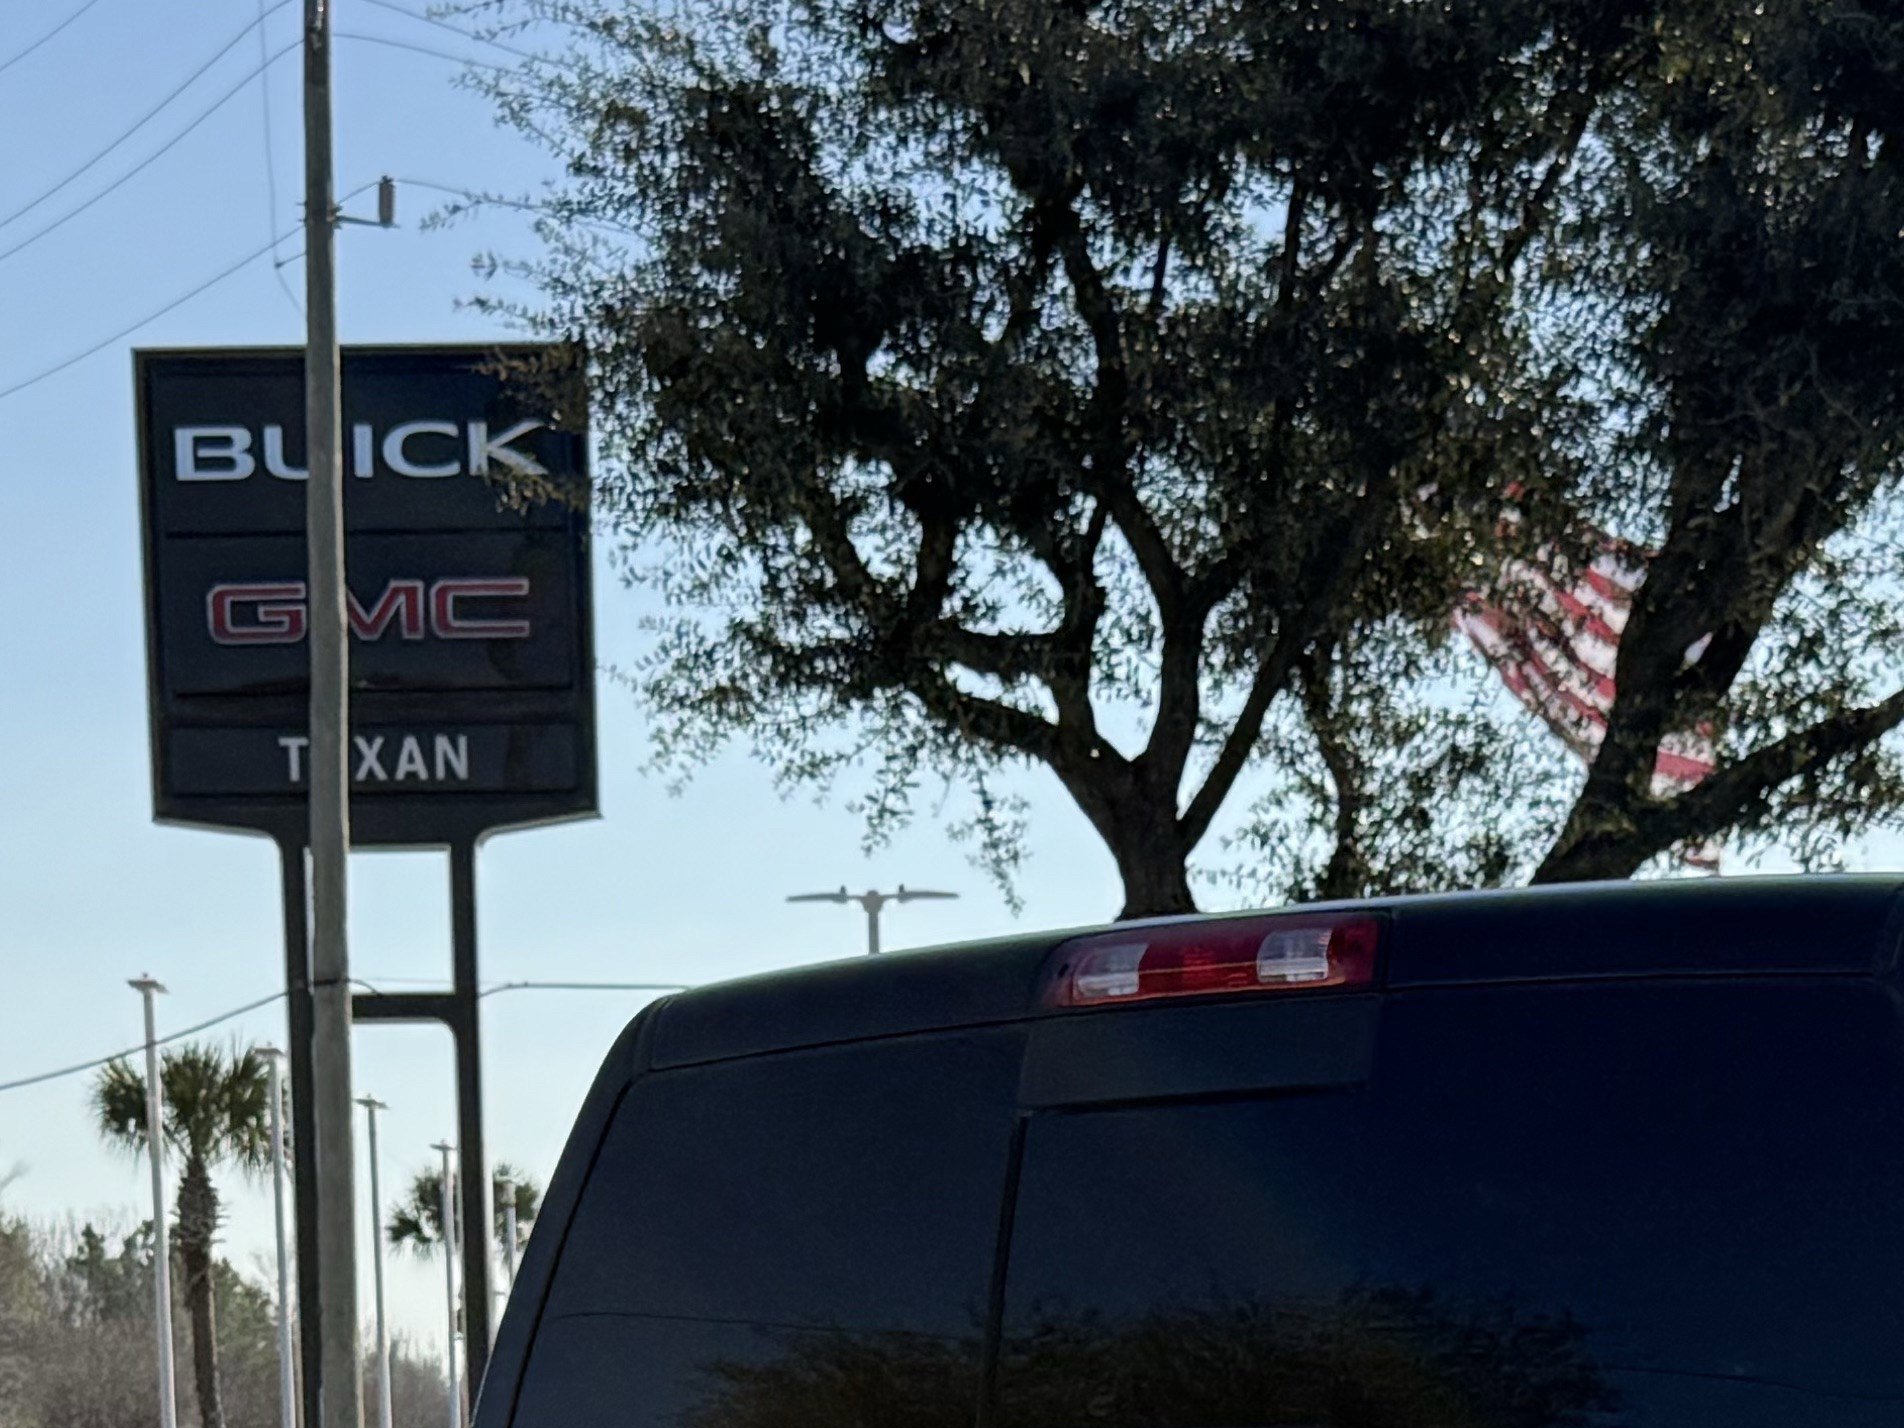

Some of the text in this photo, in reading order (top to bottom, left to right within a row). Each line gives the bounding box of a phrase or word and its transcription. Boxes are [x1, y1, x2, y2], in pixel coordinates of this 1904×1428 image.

[173, 420, 550, 482] BUICK
[206, 576, 531, 646] GMC
[277, 734, 470, 783] TXAN
